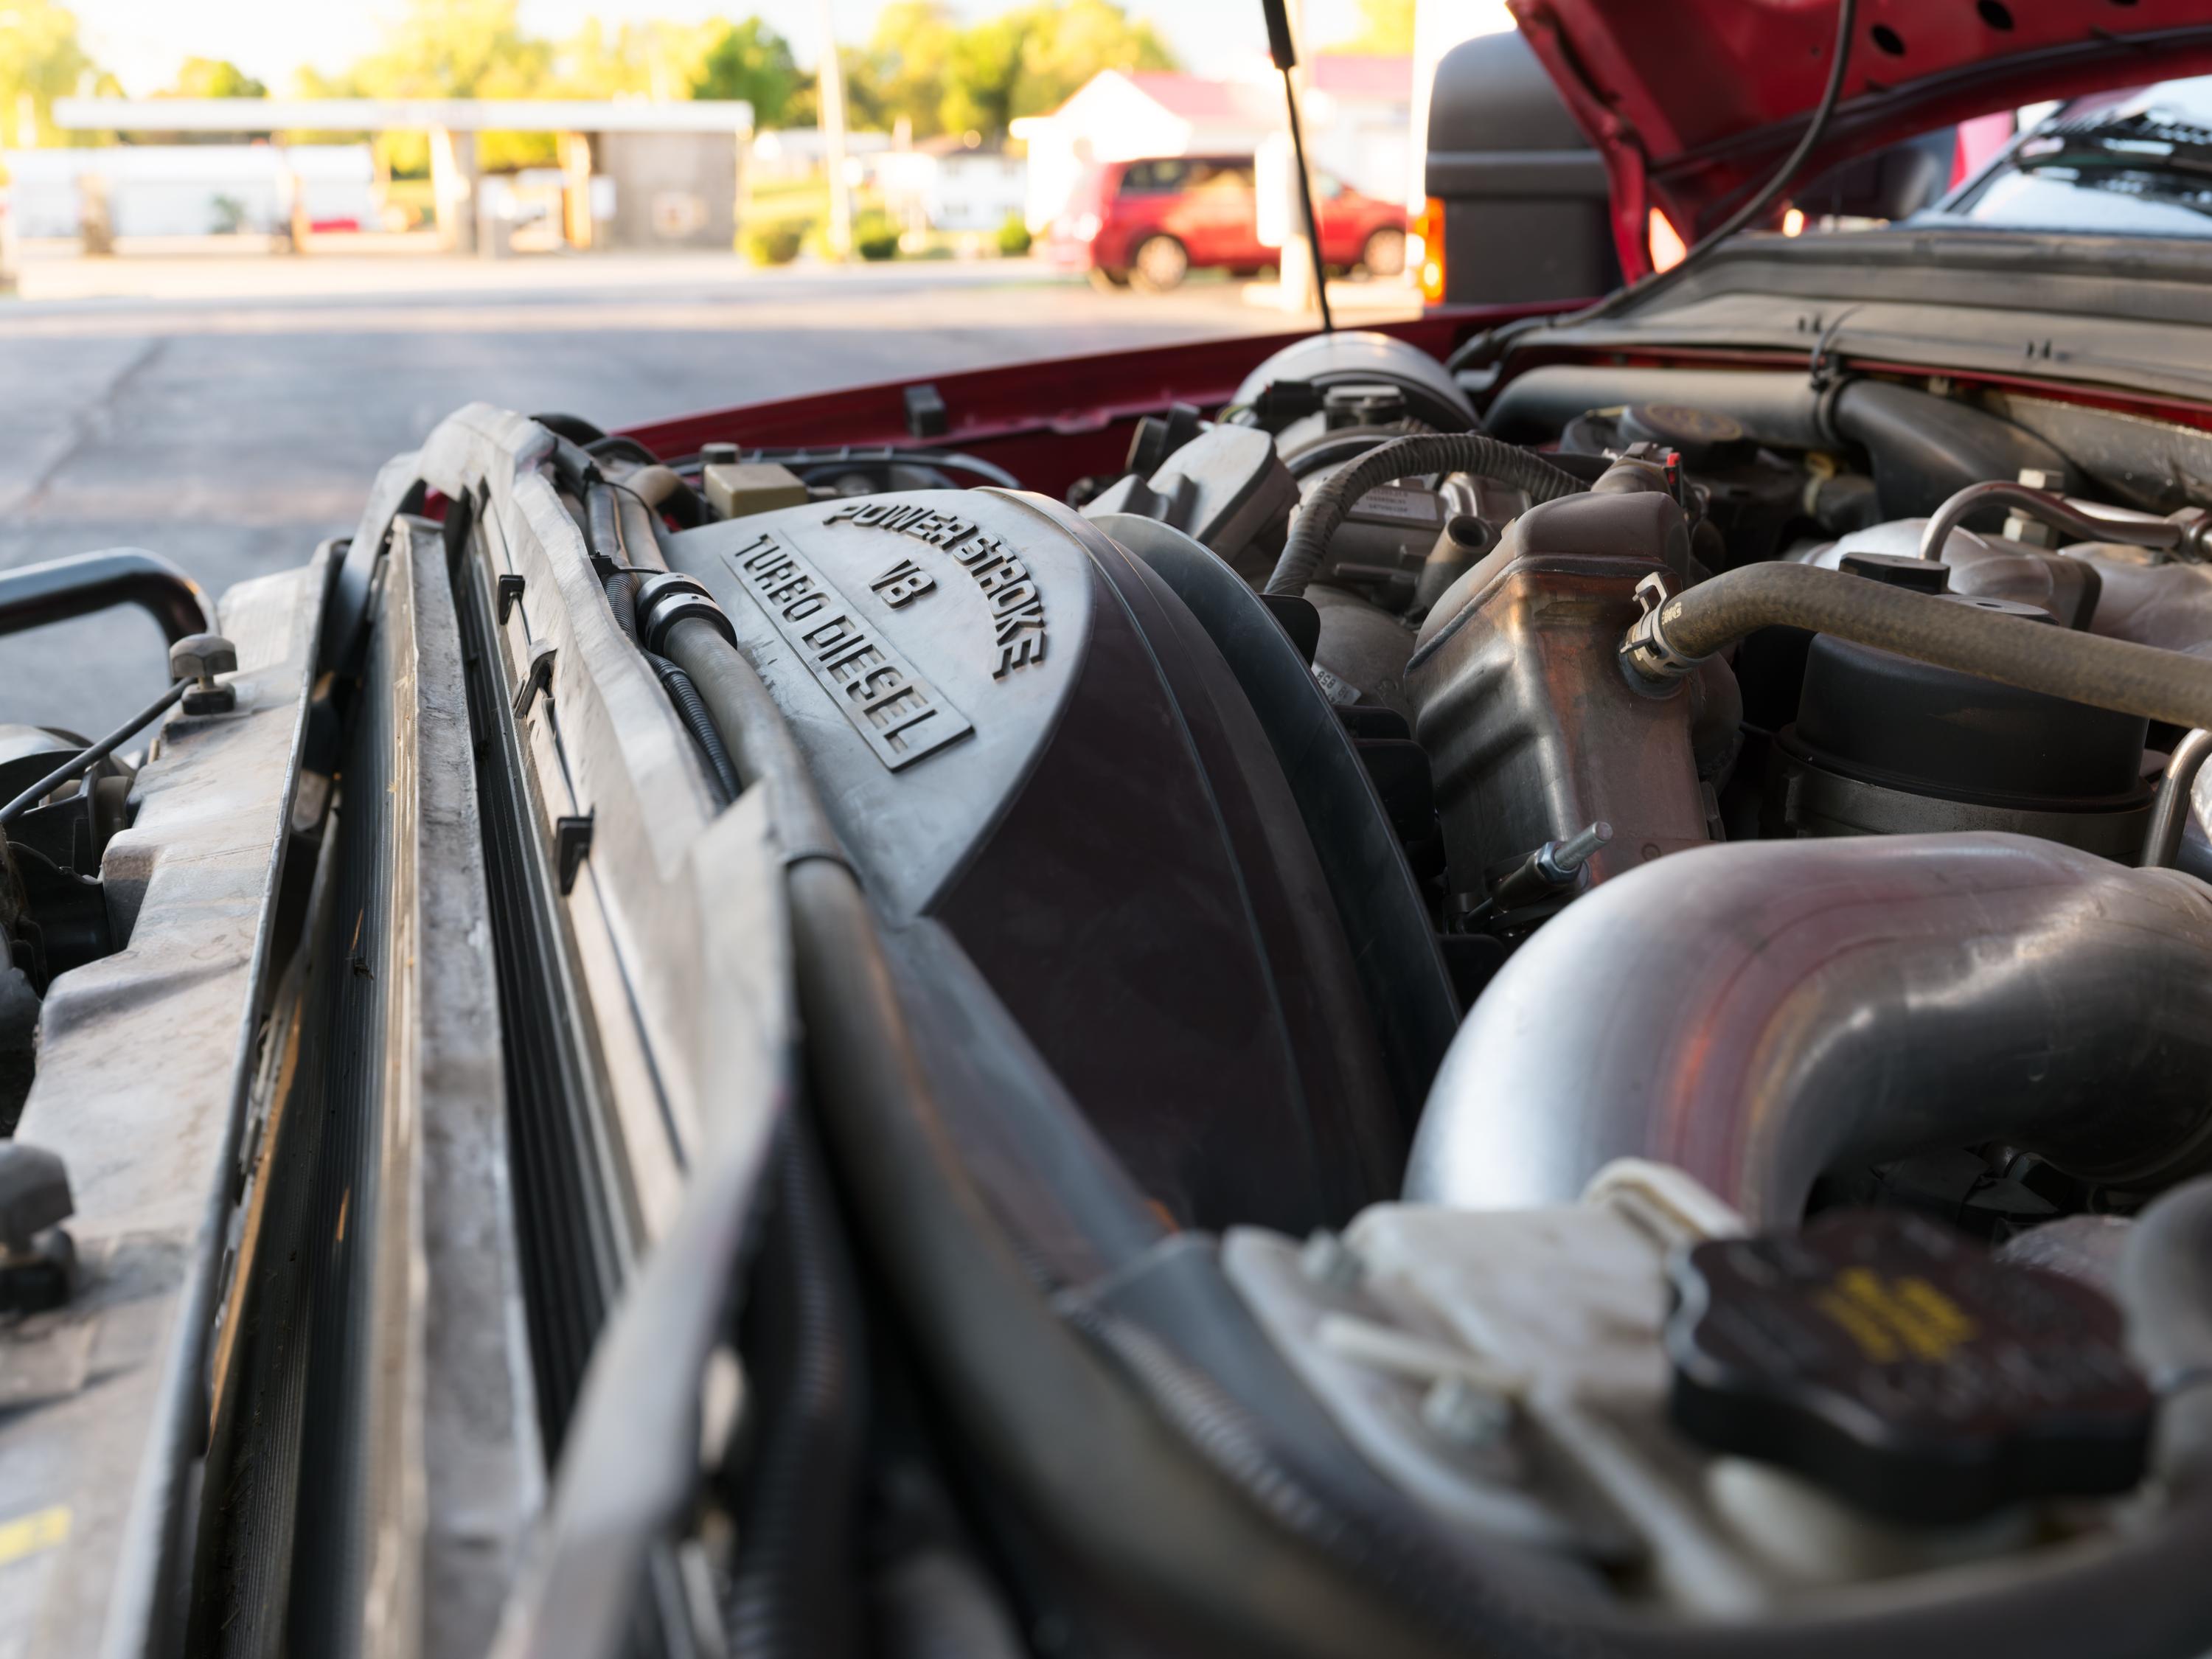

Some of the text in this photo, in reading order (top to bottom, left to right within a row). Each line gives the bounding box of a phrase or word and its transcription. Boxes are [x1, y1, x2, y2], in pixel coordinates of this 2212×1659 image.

[734, 533, 939, 754] TURBO DIESEL
[822, 504, 1048, 681] POWER STROKE
[868, 559, 938, 611] V8
